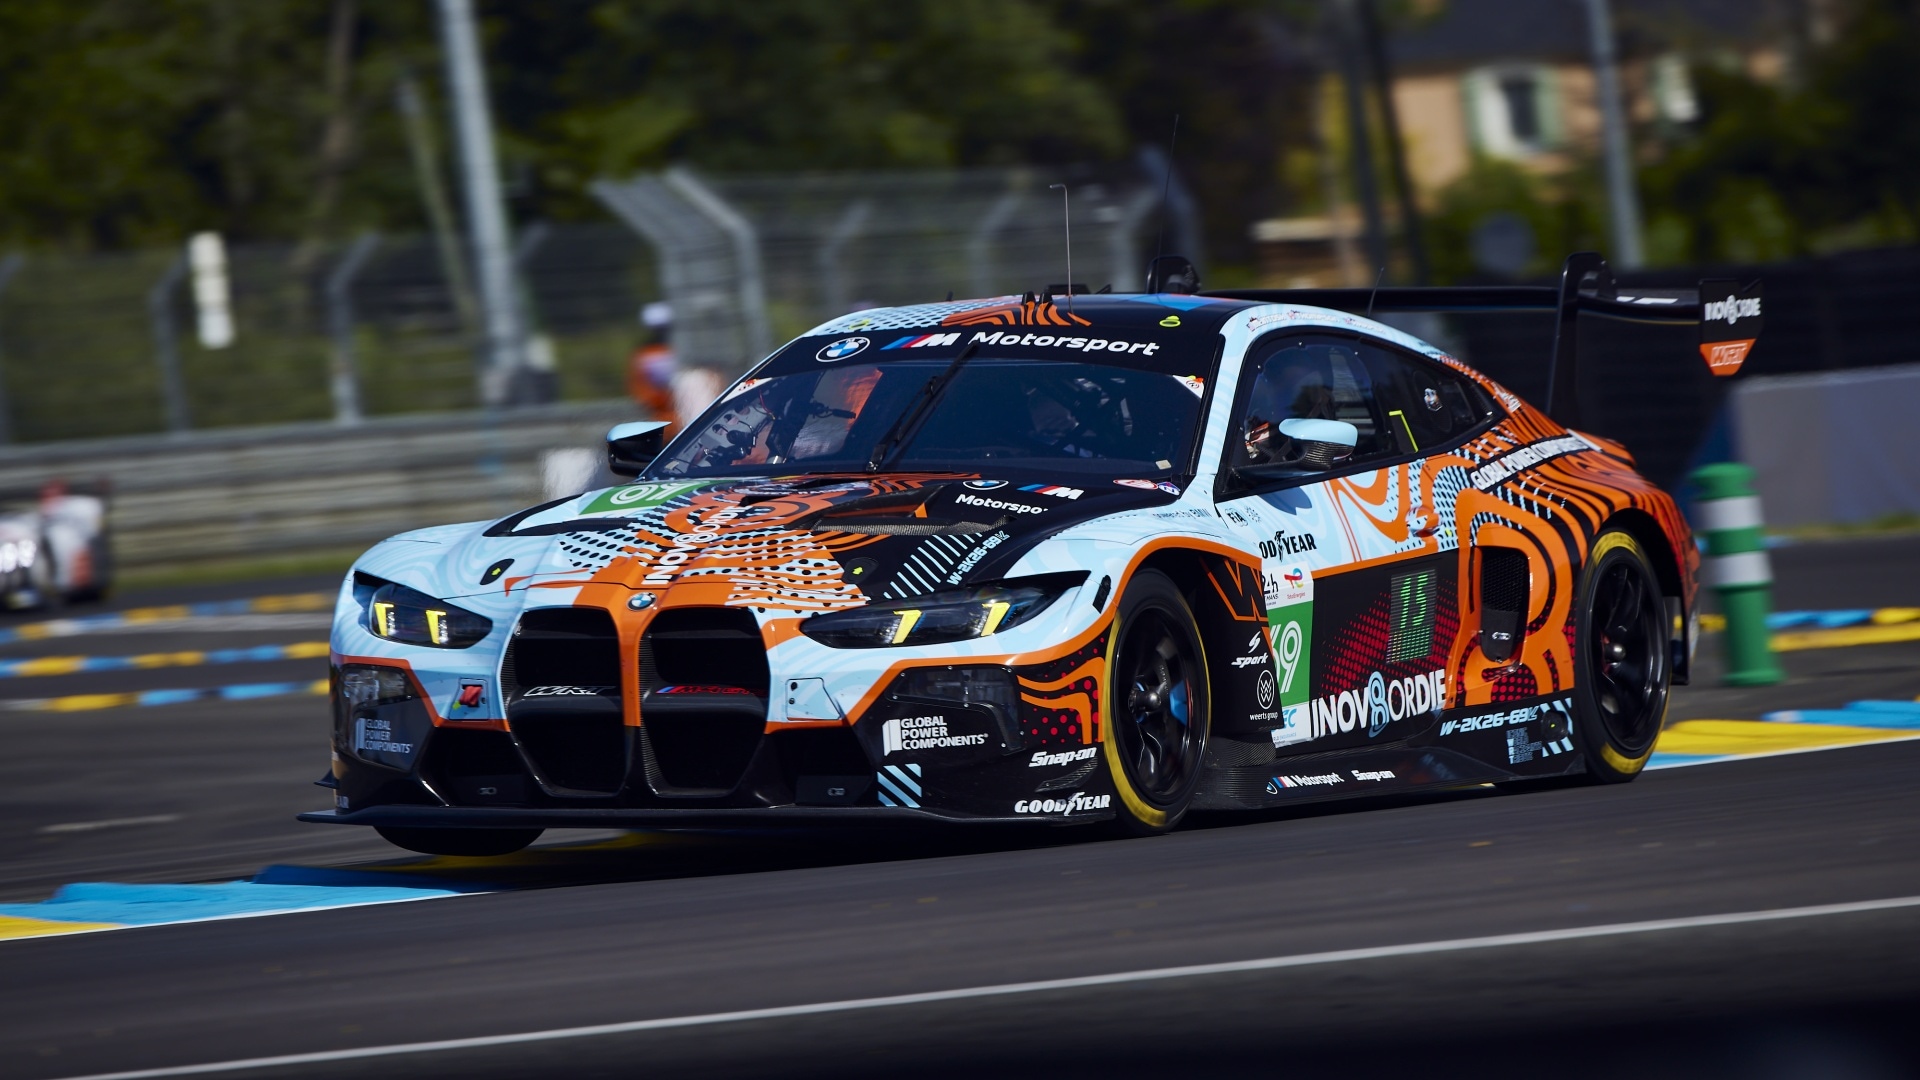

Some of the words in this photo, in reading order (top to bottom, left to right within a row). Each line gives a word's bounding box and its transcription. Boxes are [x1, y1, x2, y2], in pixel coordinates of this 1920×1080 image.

[966, 331, 1160, 357] Motorsport
[955, 493, 1048, 514] Motorspo
[1258, 530, 1317, 562] ODYEAR
[1400, 571, 1429, 629] 15
[1231, 653, 1269, 668] spark
[1311, 669, 1447, 739] INOV8ORDIE
[366, 719, 392, 730] GLOBAL
[900, 715, 947, 729] GLOBAL
[1249, 712, 1267, 721] weerts
[1283, 708, 1297, 728] EC
[366, 730, 391, 741] POWER
[901, 727, 948, 740] POWER
[1028, 747, 1097, 768] Snap-on
[1290, 772, 1345, 787] Motorsport
[1350, 769, 1396, 782] Snap-on
[1014, 792, 1111, 817] GOODYEAR
